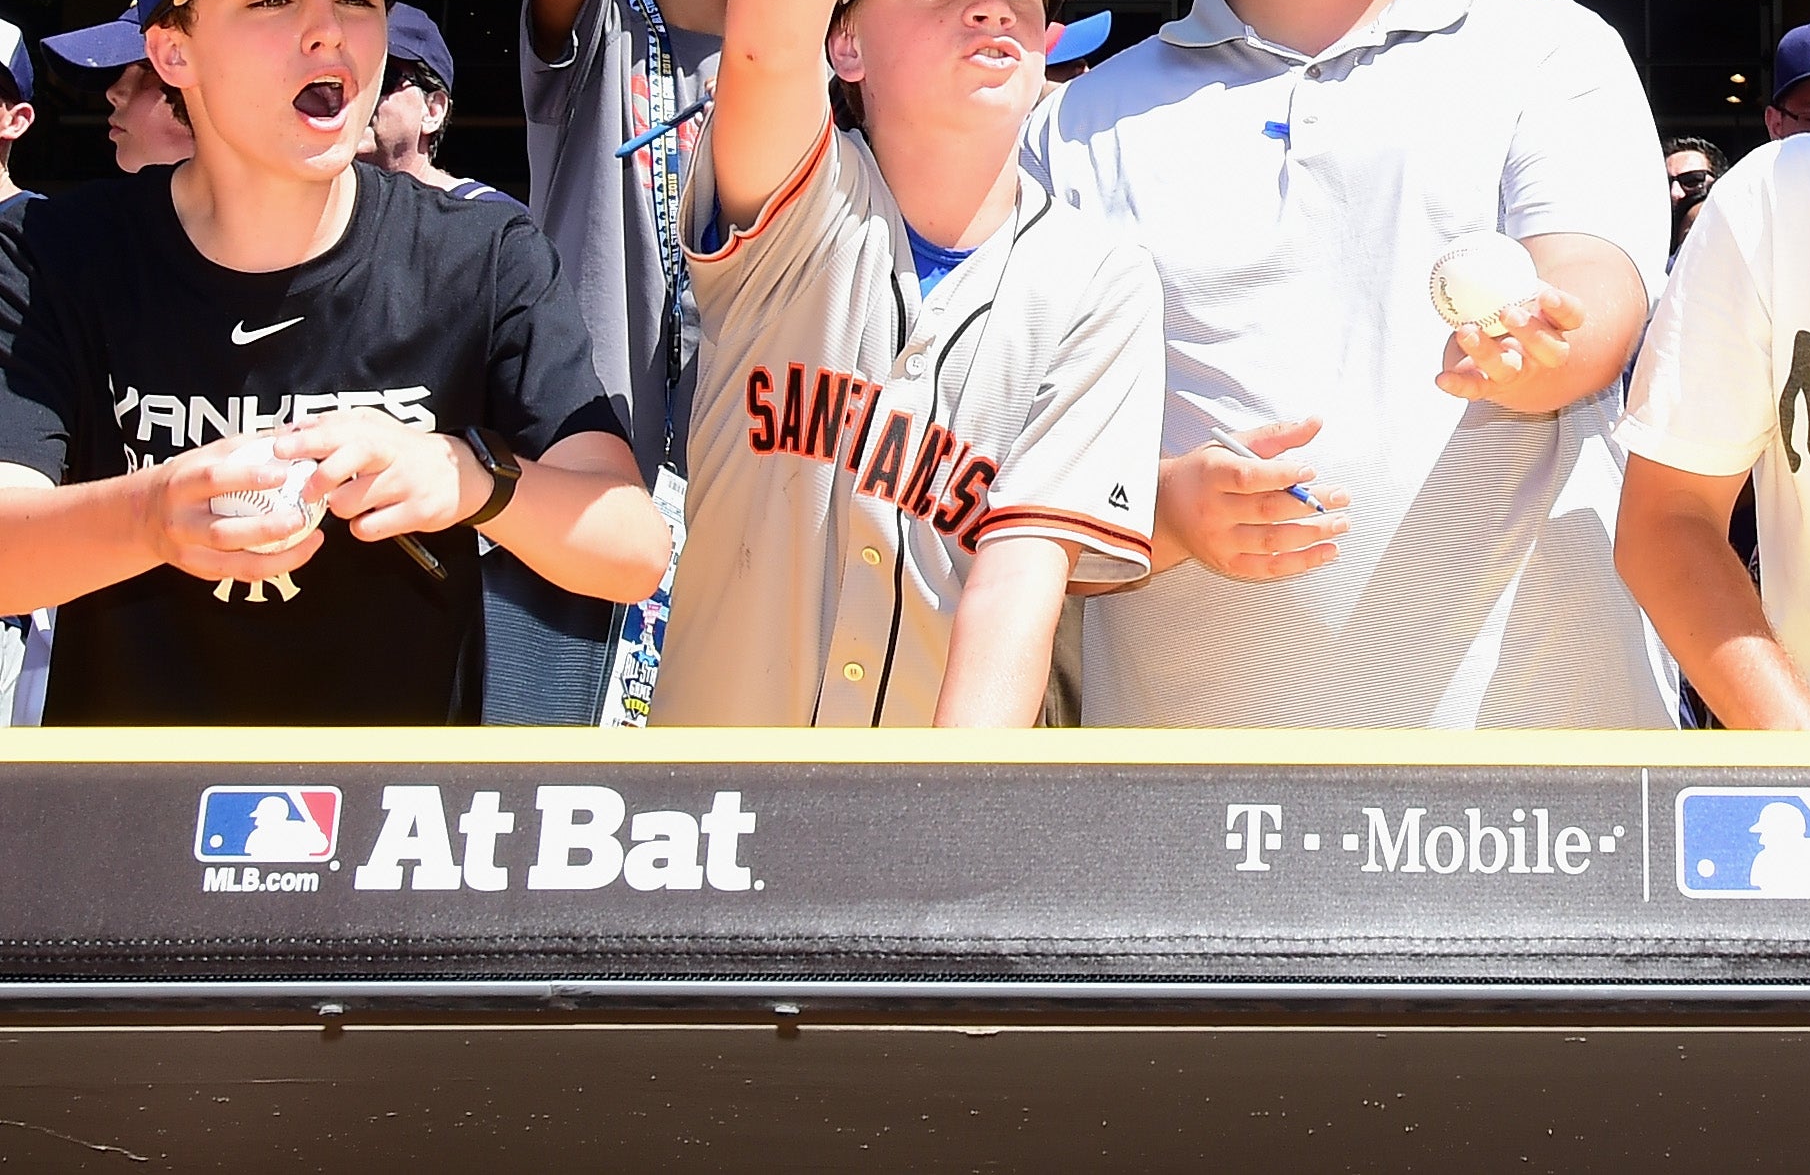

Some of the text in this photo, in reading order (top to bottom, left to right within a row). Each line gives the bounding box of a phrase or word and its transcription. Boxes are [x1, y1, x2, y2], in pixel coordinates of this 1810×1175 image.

[746, 362, 852, 464] SAN
[203, 868, 319, 892] MLB.com
[355, 786, 757, 891] At Bat
